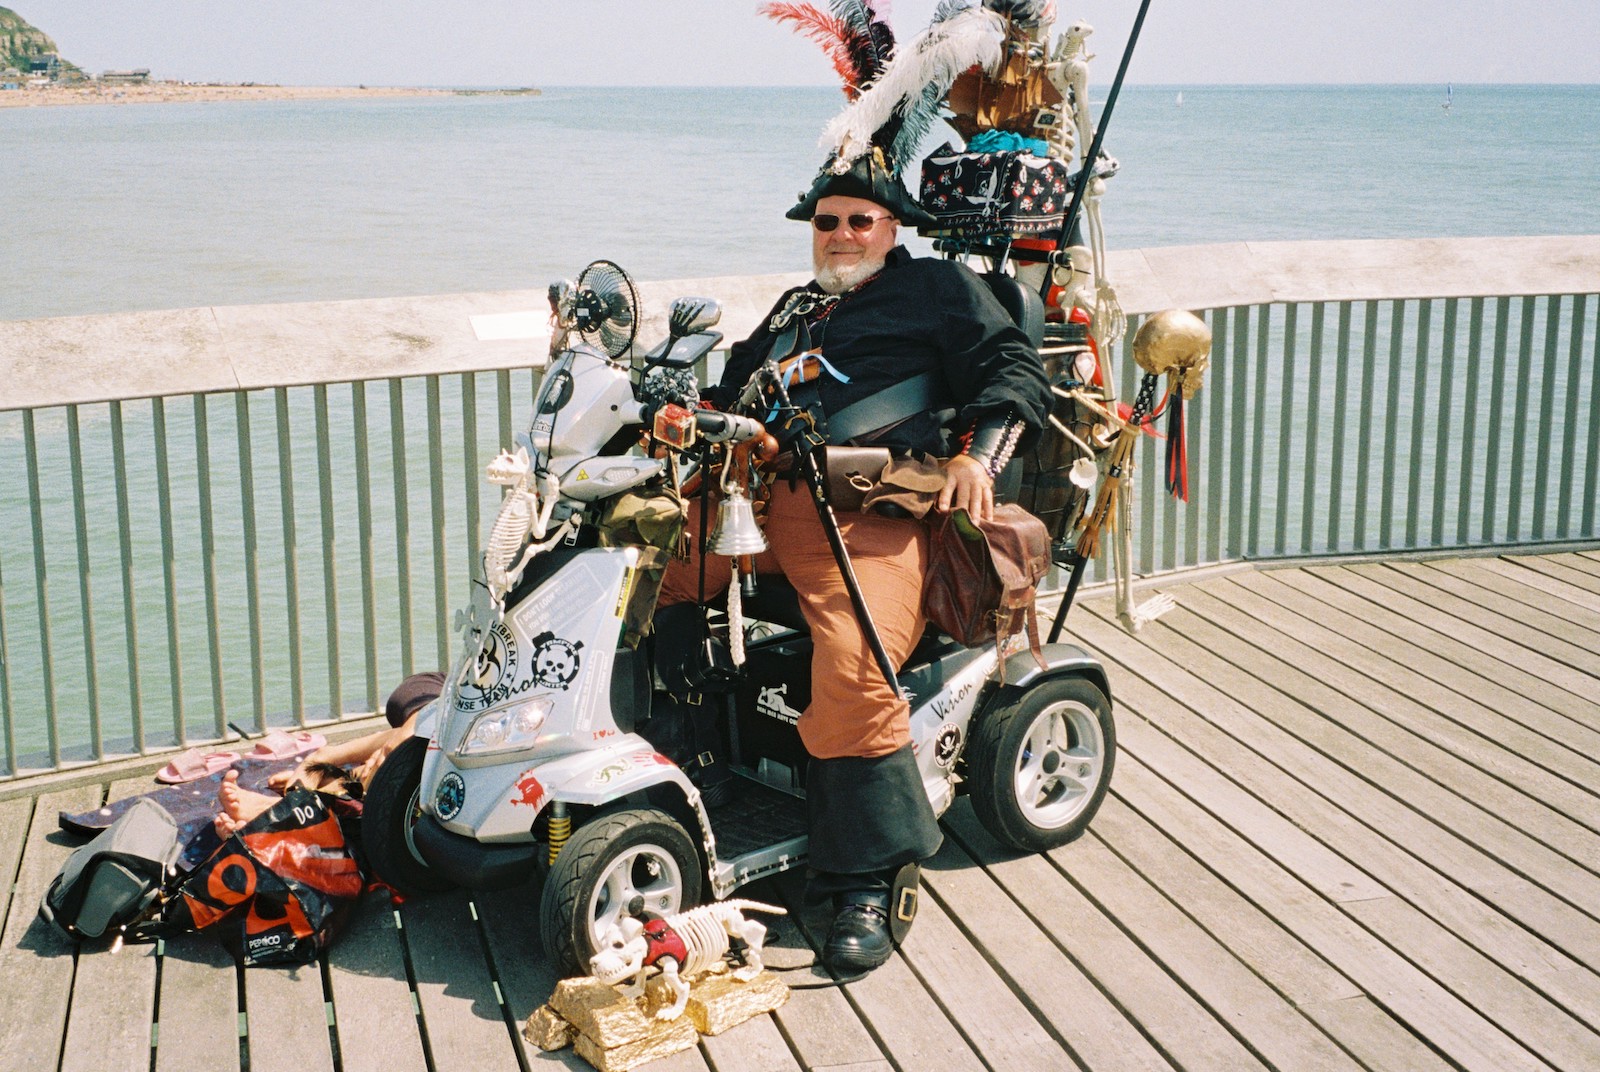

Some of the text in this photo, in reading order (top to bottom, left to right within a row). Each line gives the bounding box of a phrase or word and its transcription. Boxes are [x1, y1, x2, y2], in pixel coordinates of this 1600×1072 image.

[521, 603, 541, 622] DON'T
[538, 591, 557, 609] LOOK
[492, 620, 516, 666] UTBREAK
[540, 640, 577, 656] VAMPIRE
[931, 683, 972, 720] Vision
[937, 724, 956, 741] PIRATE
